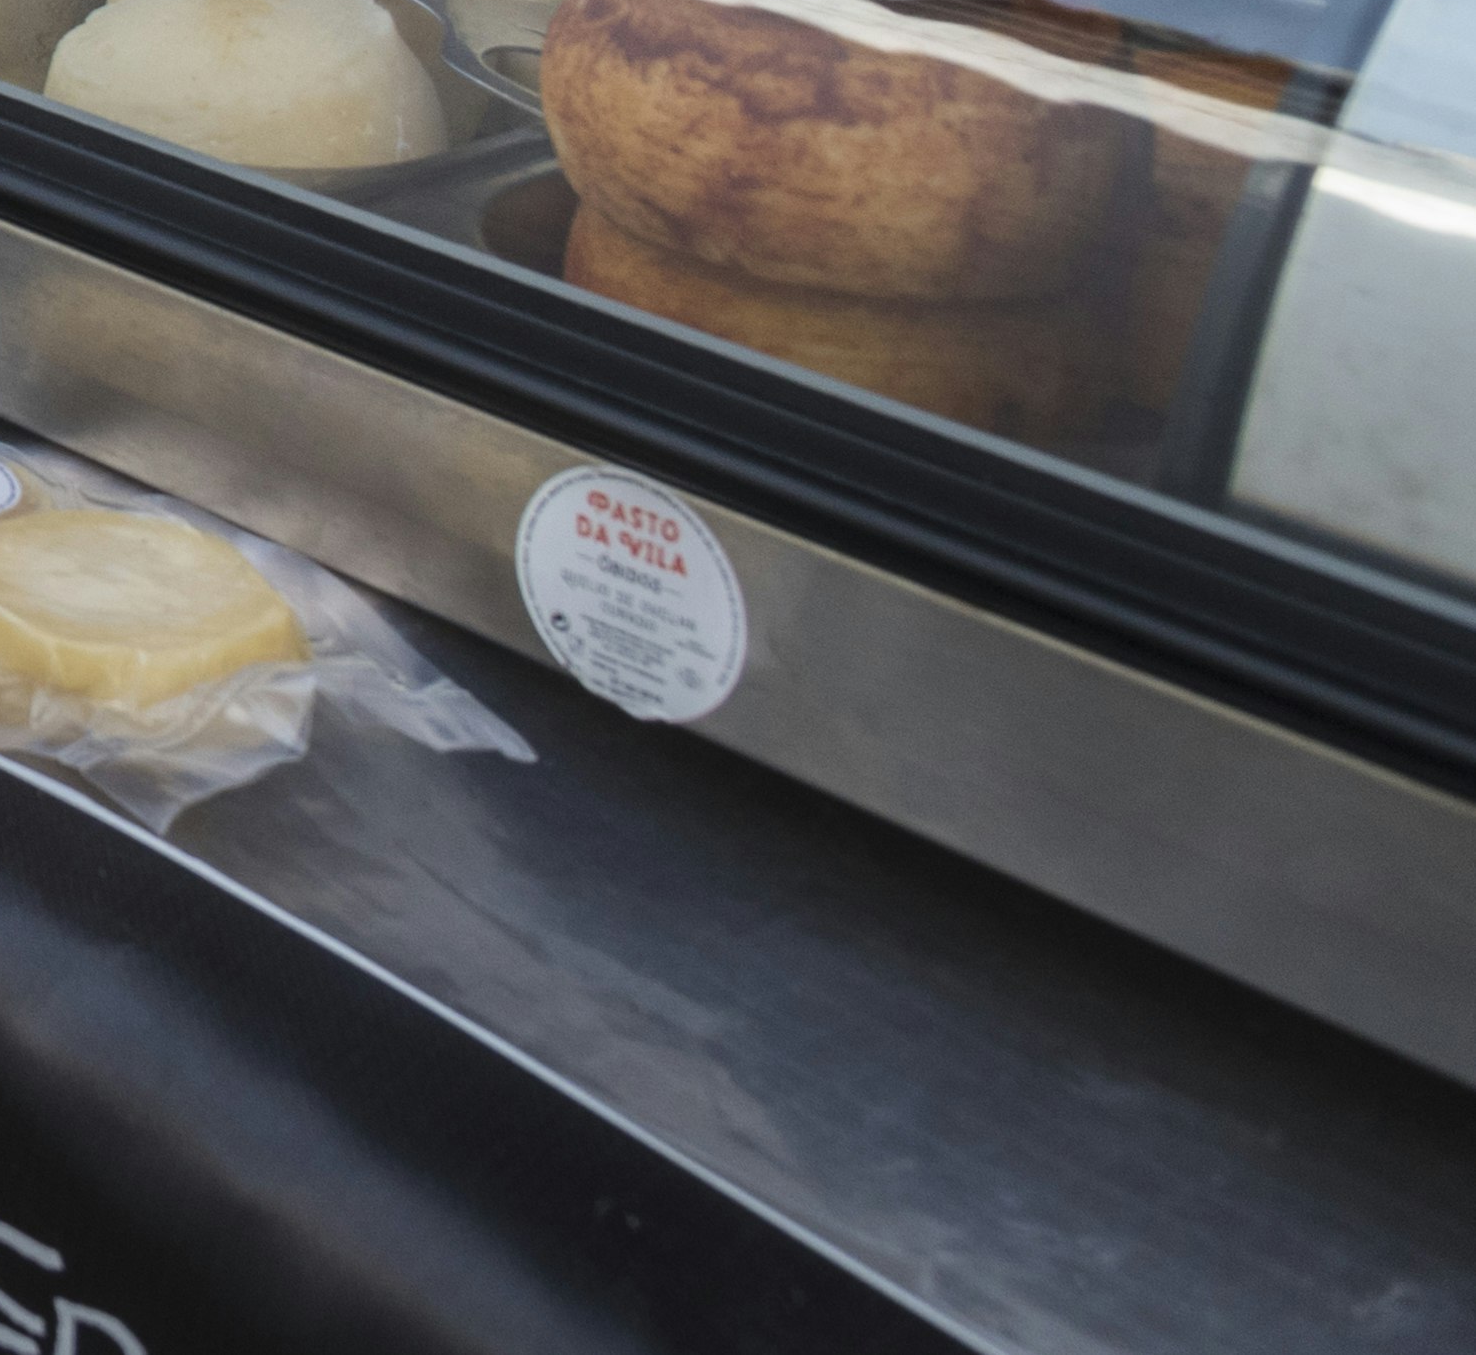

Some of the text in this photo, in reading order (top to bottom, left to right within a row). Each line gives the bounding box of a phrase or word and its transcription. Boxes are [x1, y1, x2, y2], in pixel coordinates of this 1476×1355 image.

[575, 513, 688, 578] DA VILA
[586, 489, 681, 544] PASTO
